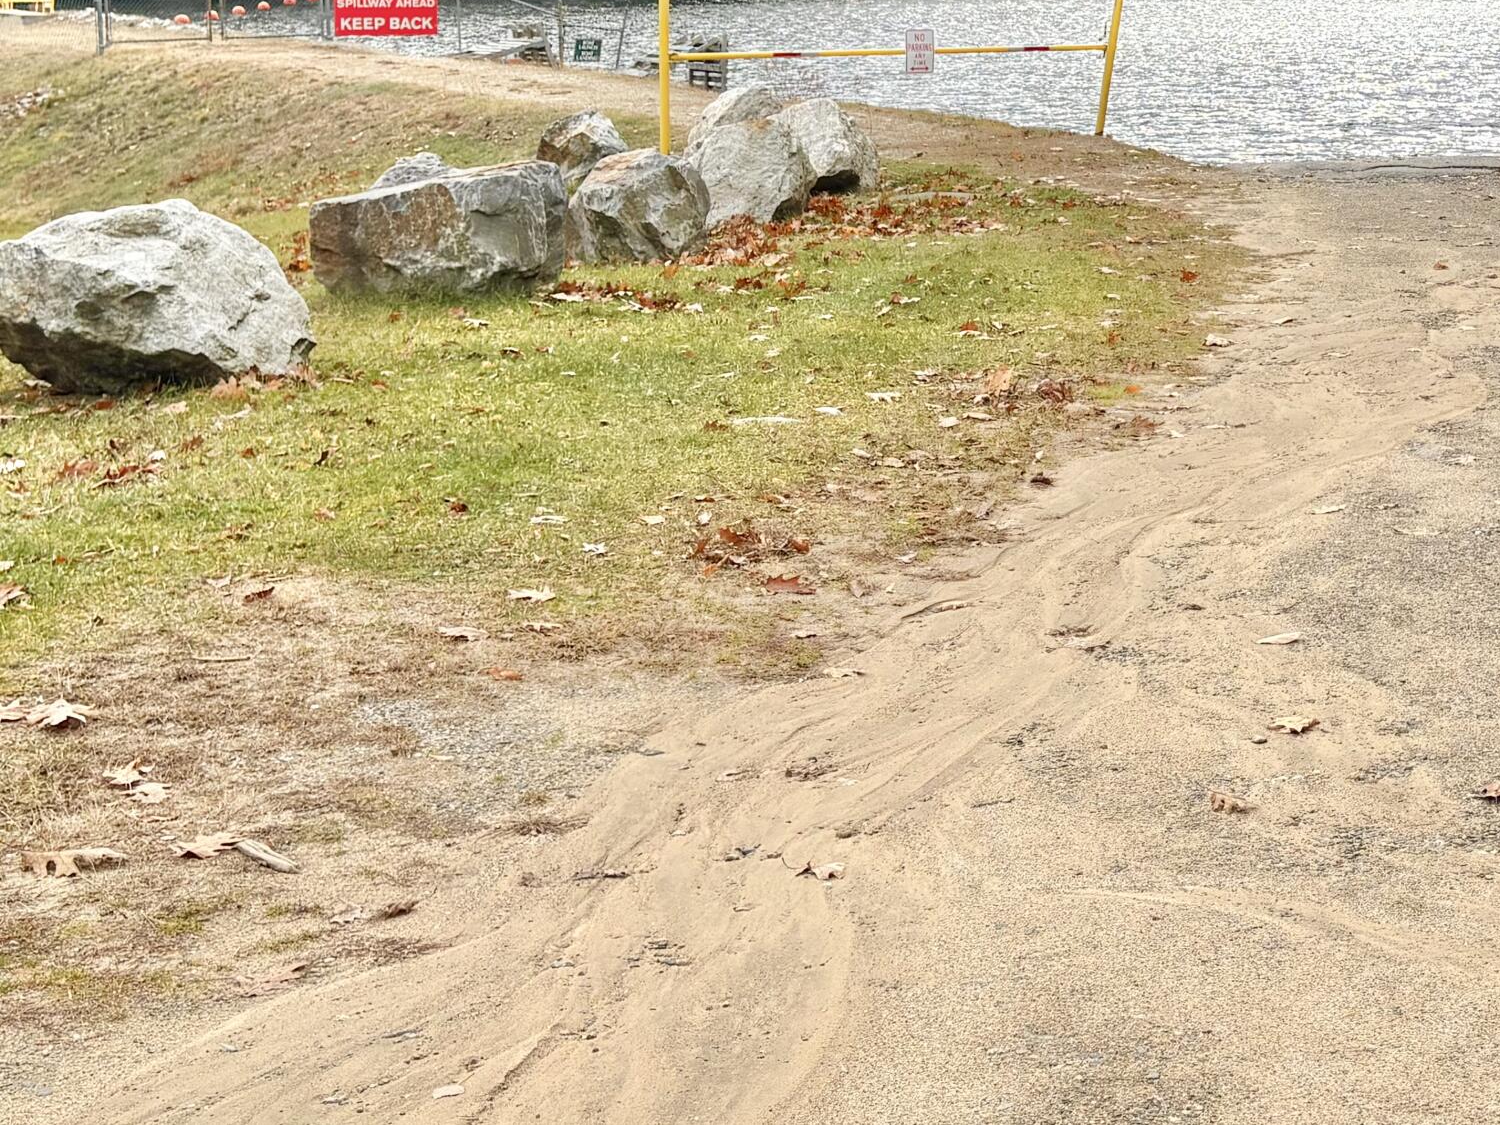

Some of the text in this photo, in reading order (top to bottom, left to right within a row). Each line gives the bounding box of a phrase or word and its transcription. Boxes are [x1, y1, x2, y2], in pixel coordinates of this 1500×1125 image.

[340, 16, 434, 31] KEEP BACK
[914, 33, 925, 42] NO
[907, 43, 932, 52] PARKING
